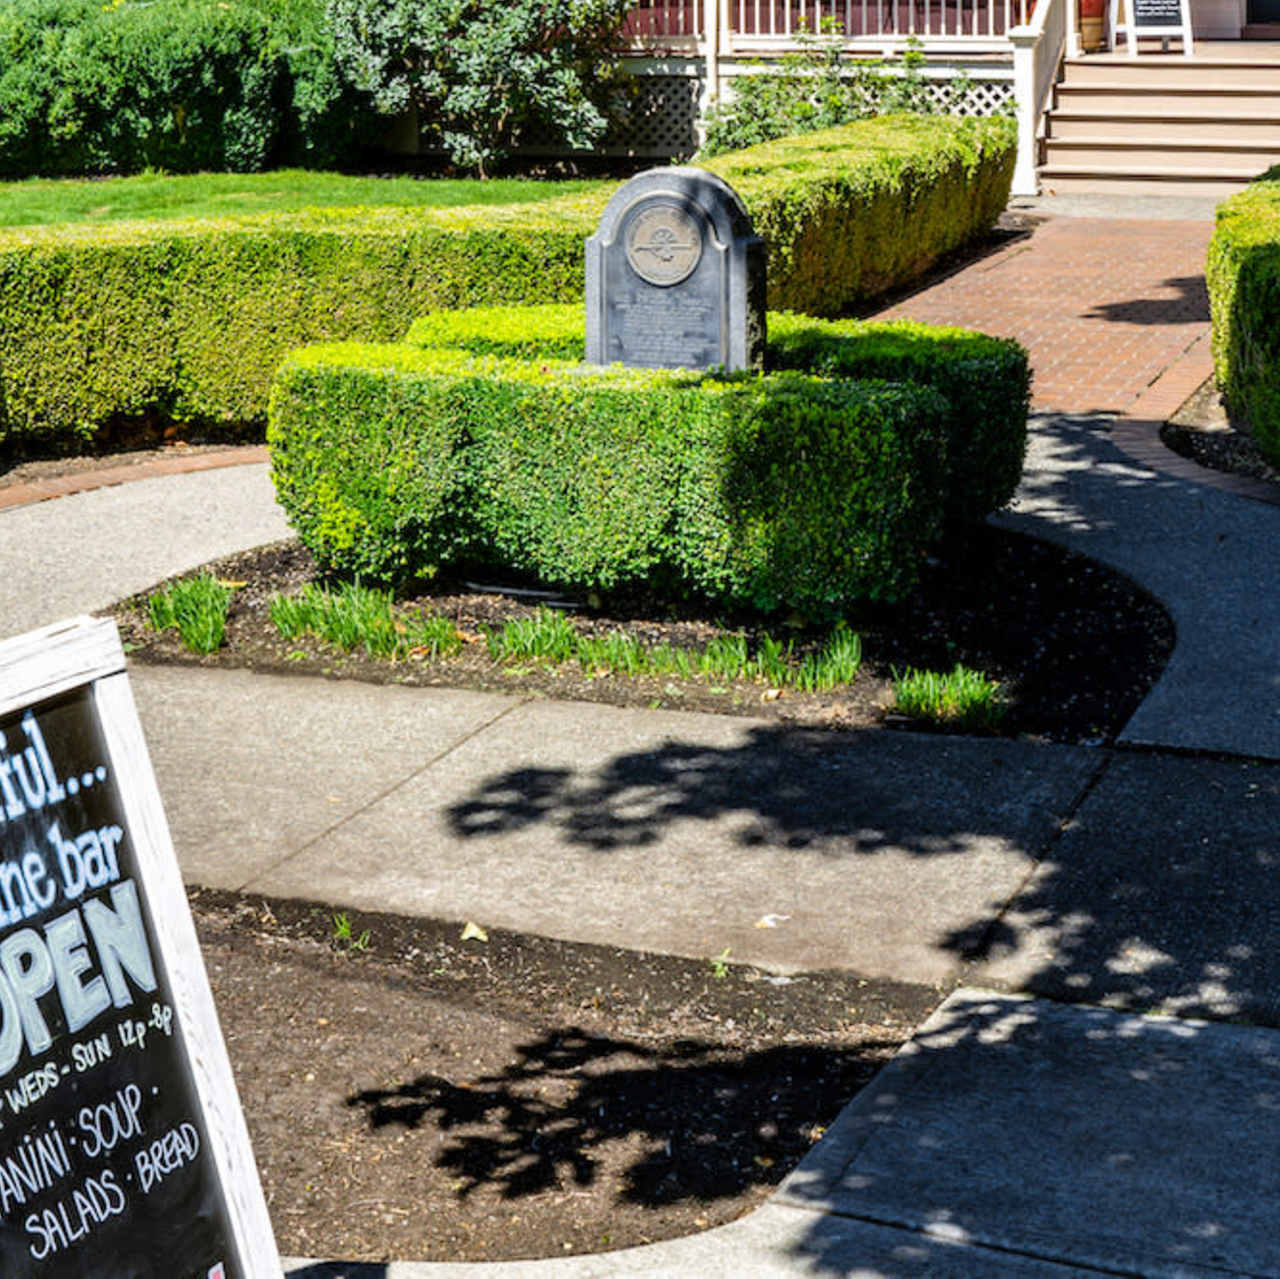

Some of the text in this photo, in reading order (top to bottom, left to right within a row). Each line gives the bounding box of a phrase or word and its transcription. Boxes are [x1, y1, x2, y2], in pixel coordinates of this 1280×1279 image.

[46, 820, 124, 900] bar
[79, 1083, 143, 1157] SOUP
[25, 1122, 199, 1260] SALADS BREAD
